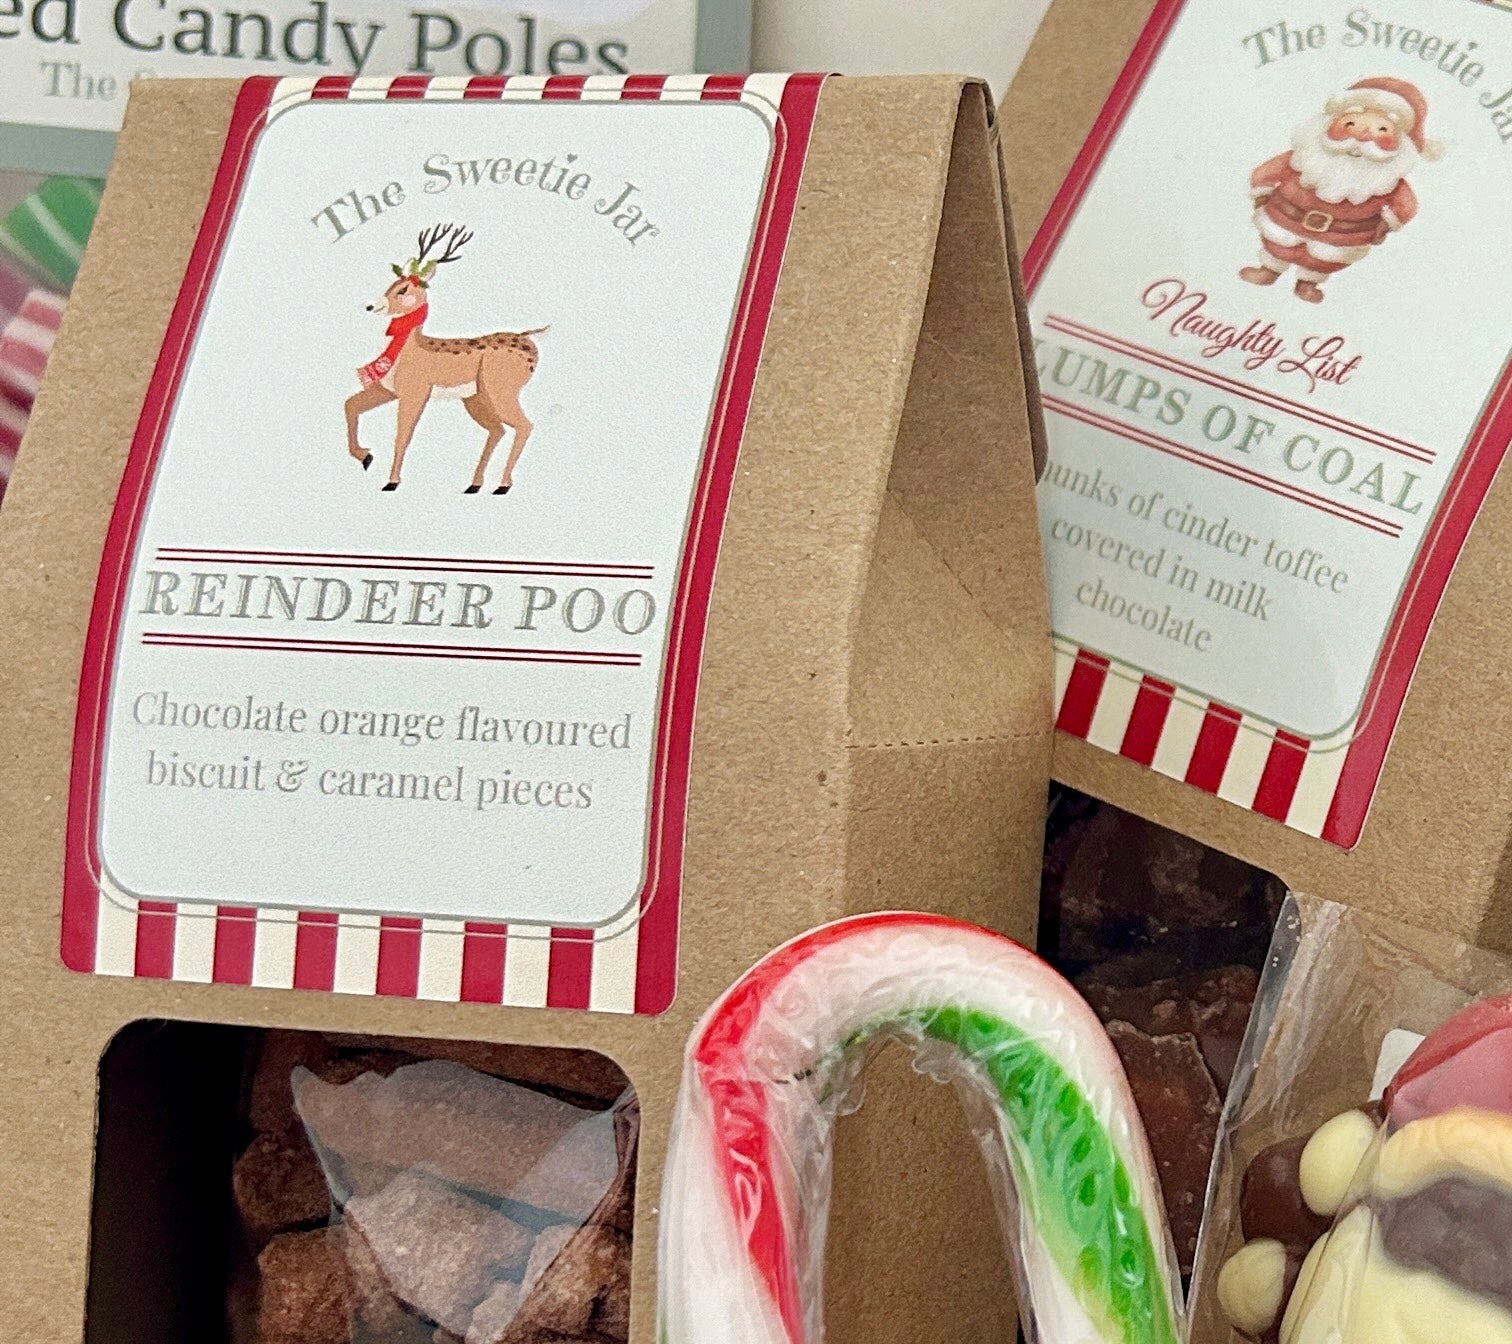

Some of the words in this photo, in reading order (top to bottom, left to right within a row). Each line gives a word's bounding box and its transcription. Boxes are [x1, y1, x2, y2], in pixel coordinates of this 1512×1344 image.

[40, 60, 117, 101] The
[409, 12, 630, 76] Poles
[1242, 18, 1326, 69] The
[1343, 10, 1488, 88] Sweetie
[311, 180, 405, 243] The
[423, 153, 592, 199] Sweetie
[595, 182, 661, 247] Jar
[1142, 279, 1284, 365] Naughty
[1277, 336, 1363, 393] List
[1202, 404, 1277, 453] OF
[1284, 434, 1425, 516] COAL
[1051, 517, 1167, 579] covered
[1169, 556, 1198, 594] in
[1206, 570, 1273, 622] milk
[1128, 492, 1163, 521] of
[1164, 499, 1261, 559] cinder
[1262, 538, 1350, 594] toffee
[139, 570, 494, 628] REINDEER
[515, 585, 657, 636] POO
[1076, 579, 1213, 652] chocolate
[133, 691, 306, 733] Chocolate
[320, 710, 445, 745] orange
[455, 707, 632, 750] flavoured
[148, 750, 264, 791] biscuit
[275, 759, 308, 792] &
[319, 766, 463, 802] caramel
[477, 773, 594, 810] pieces
